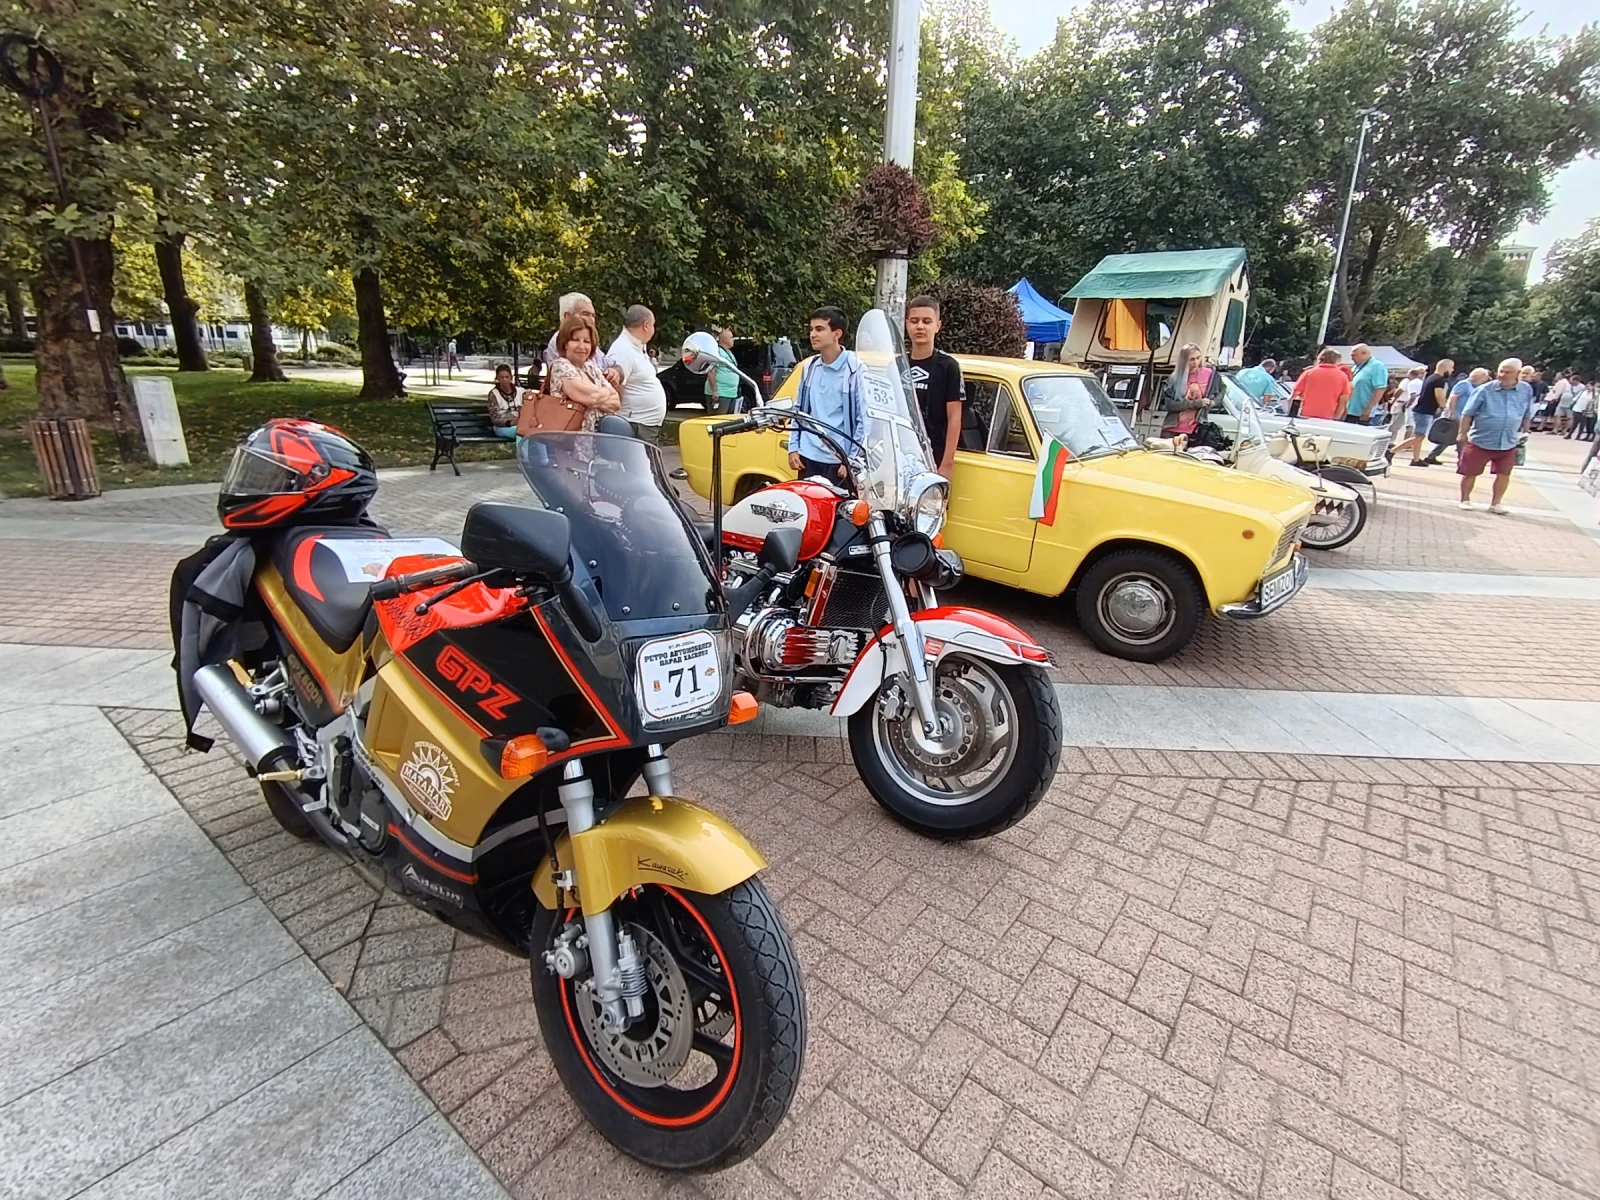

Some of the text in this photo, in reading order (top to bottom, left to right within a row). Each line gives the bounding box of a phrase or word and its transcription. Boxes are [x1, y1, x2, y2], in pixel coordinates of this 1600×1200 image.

[873, 388, 889, 404] 53
[751, 505, 795, 519] VALKYRIE
[644, 652, 668, 663] РЕТРО
[659, 658, 682, 666] ПАРАД
[435, 644, 522, 720] GPZ
[668, 664, 702, 698] 71
[403, 766, 449, 815] MATAHARI
[637, 856, 689, 881] Kawasaki
